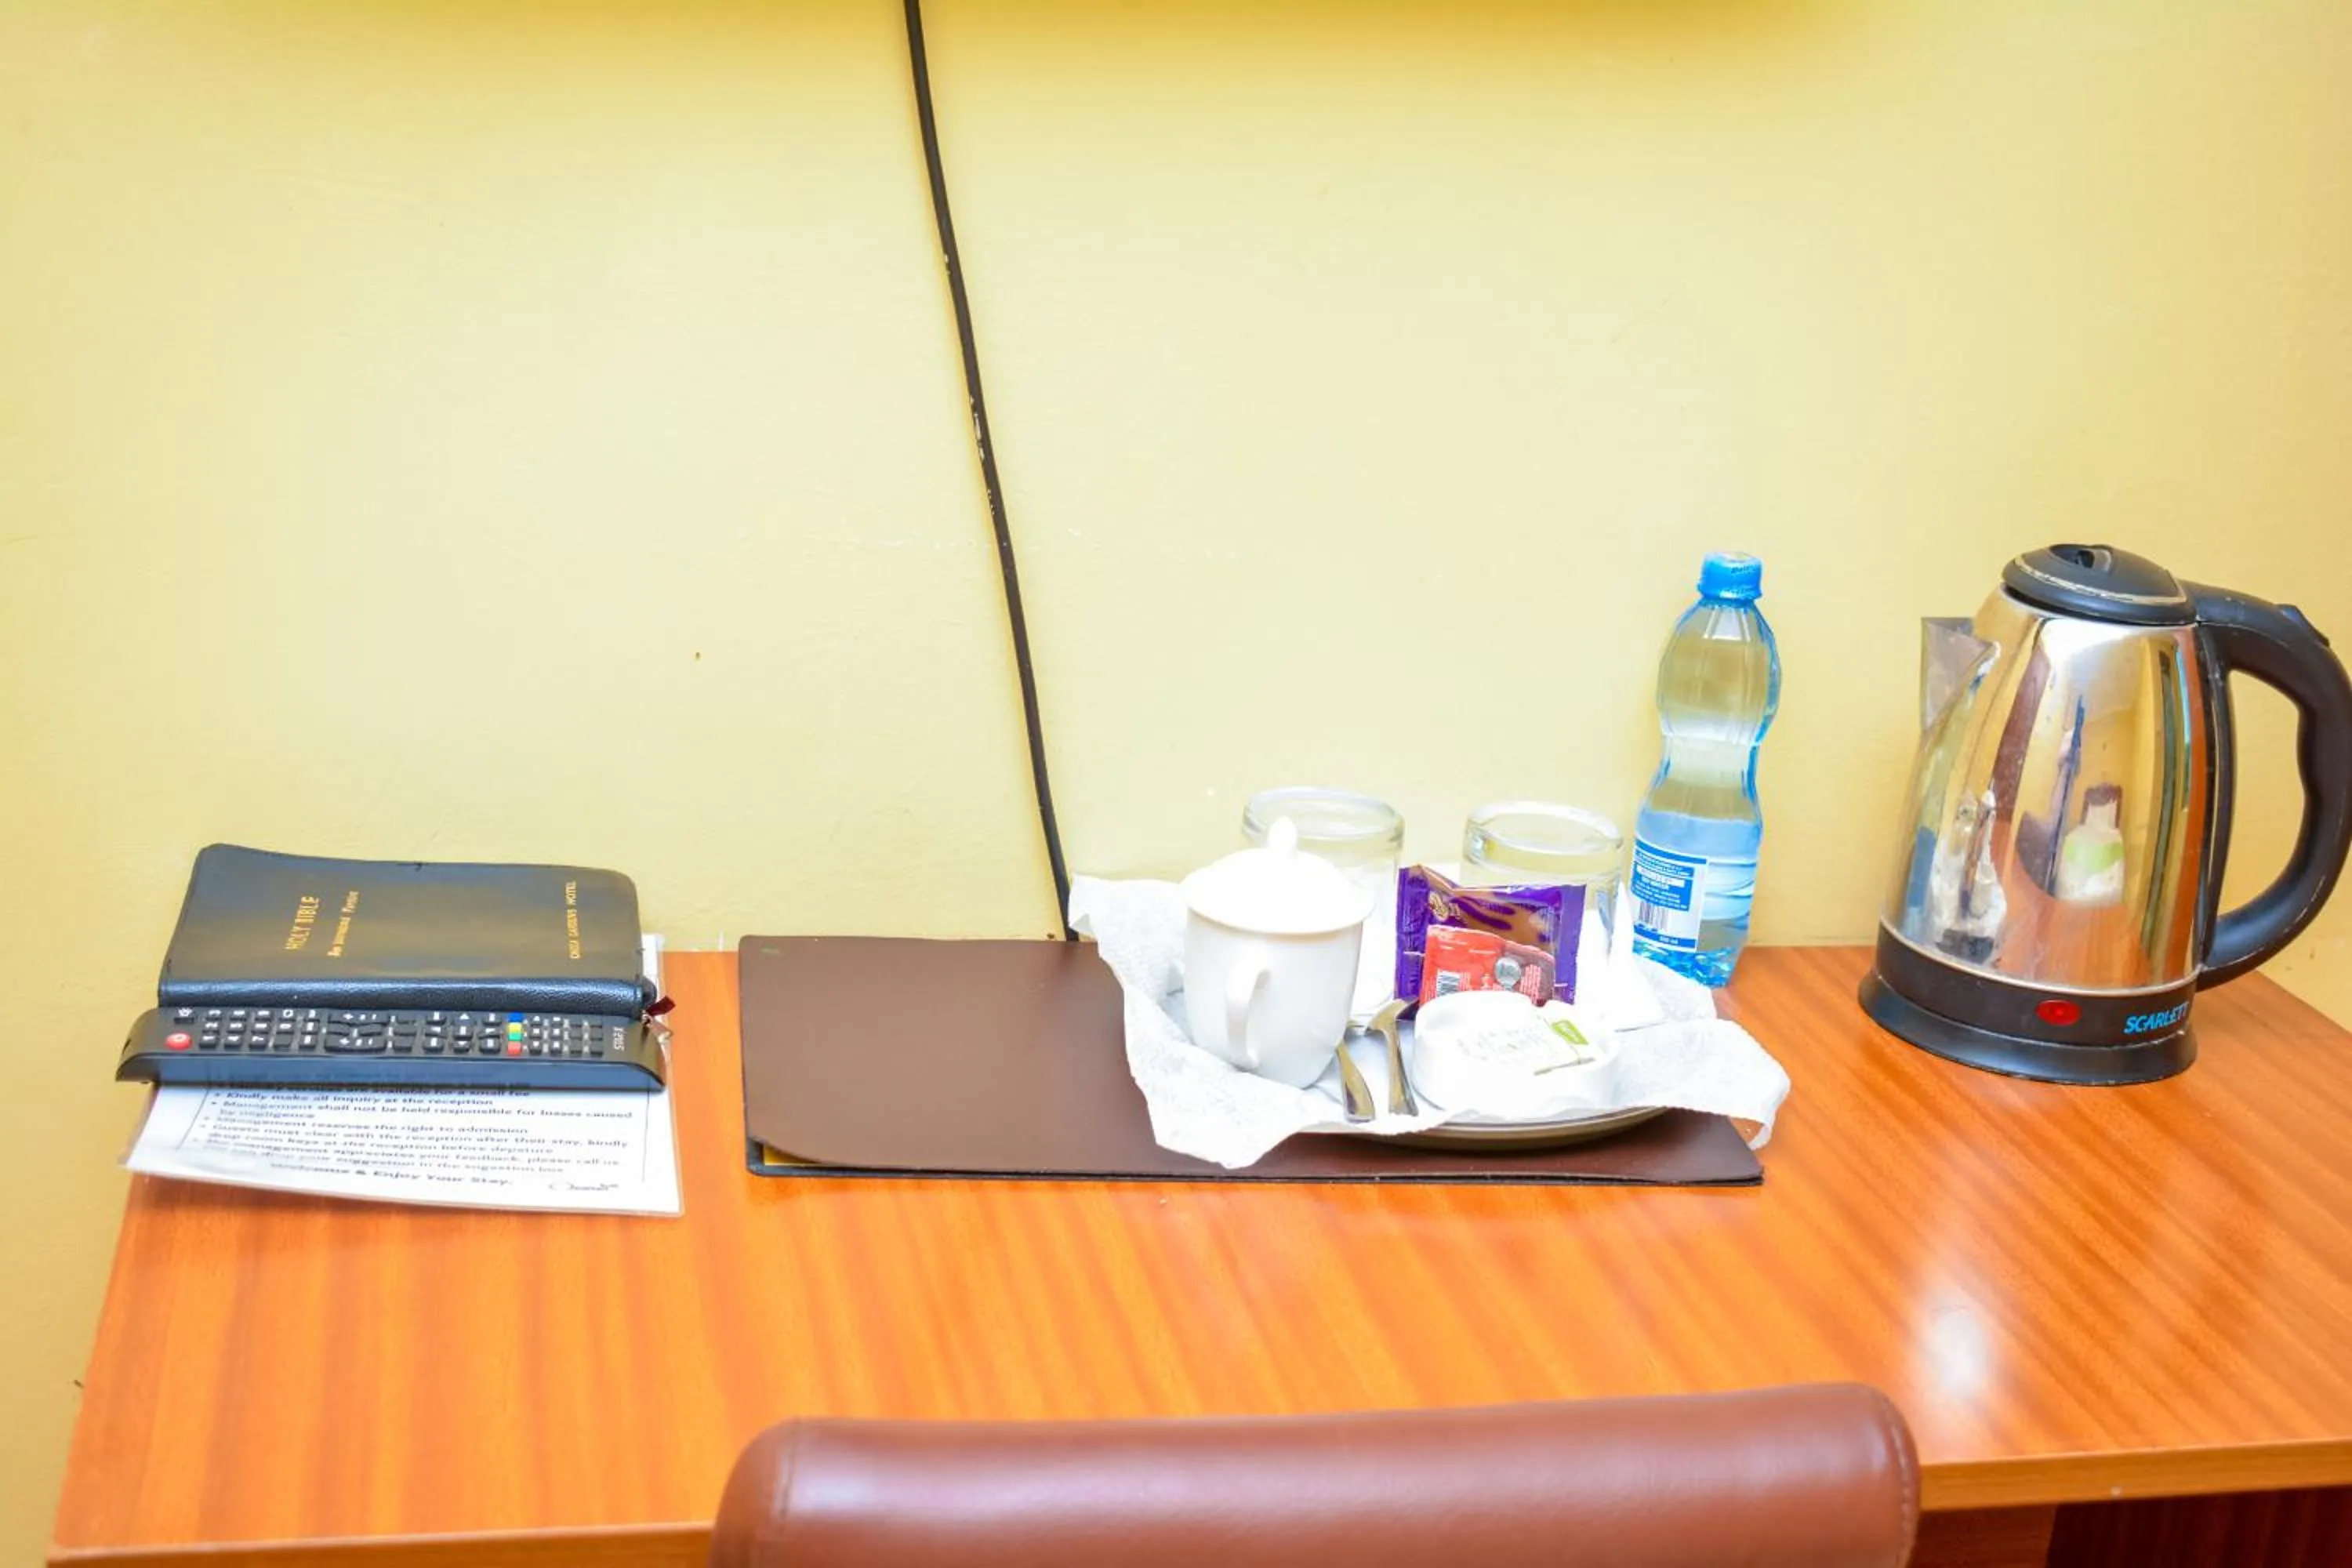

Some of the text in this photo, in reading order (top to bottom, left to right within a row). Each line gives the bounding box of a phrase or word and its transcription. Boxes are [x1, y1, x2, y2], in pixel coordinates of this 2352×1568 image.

[564, 880, 578, 906] HOTEL
[283, 895, 320, 950] HOLY BIBLE
[2123, 1000, 2190, 1034] SCARLETT
[227, 1091, 267, 1100] Kindly
[223, 1101, 312, 1110] Management
[239, 1110, 315, 1119] negligence
[216, 1116, 307, 1127] Management
[311, 1121, 370, 1130] reserves
[402, 1124, 434, 1133] right
[457, 1125, 528, 1134] admission
[212, 1124, 260, 1133] Guests
[405, 1134, 472, 1143] reception
[587, 1138, 628, 1149] kindly
[288, 1137, 320, 1145] keys
[370, 1142, 437, 1151] reception
[441, 1143, 487, 1152] before
[233, 1141, 328, 1152] management
[333, 1149, 415, 1159] appreciates
[527, 1156, 572, 1165] please
[336, 1156, 416, 1167] suggestion
[270, 1162, 350, 1174] Welcome
[372, 1170, 421, 1180] Enjoy
[425, 1174, 465, 1183] Your
